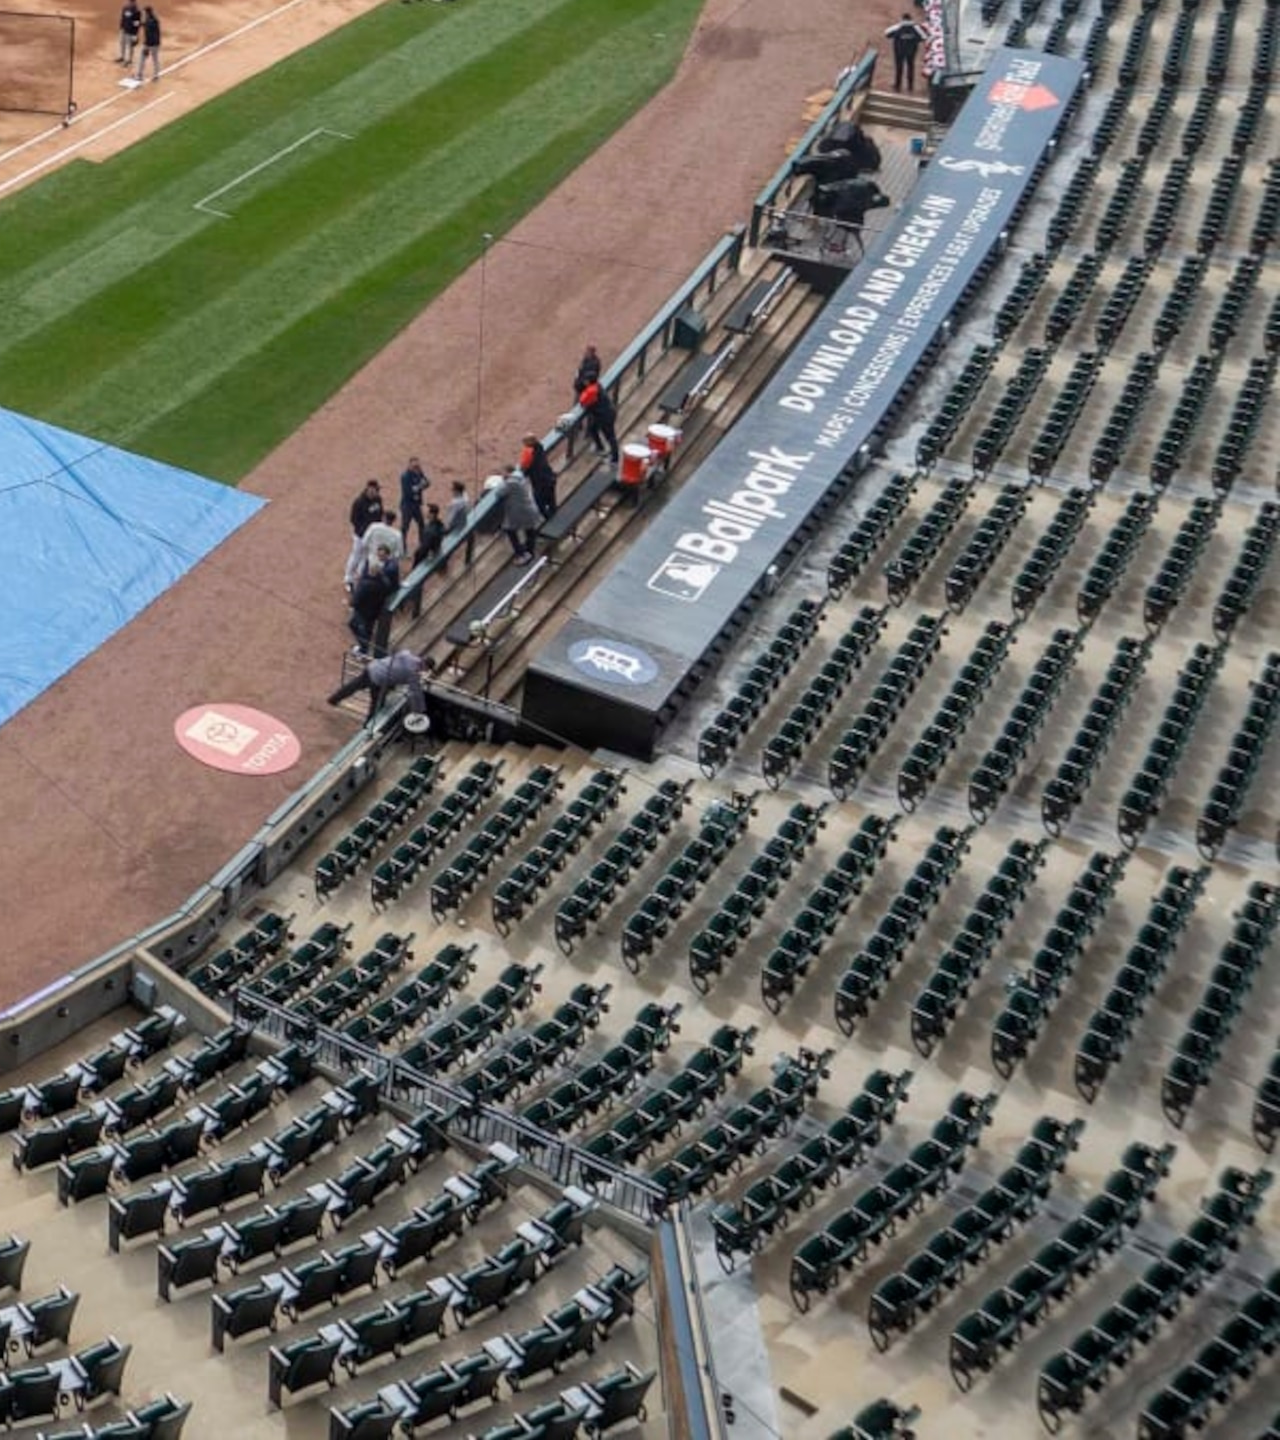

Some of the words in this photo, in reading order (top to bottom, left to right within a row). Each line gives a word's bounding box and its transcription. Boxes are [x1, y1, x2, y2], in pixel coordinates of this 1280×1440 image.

[779, 305, 880, 414] DOWNLOAD
[858, 254, 905, 308] AND
[892, 194, 958, 272] CHECK-IN
[815, 415, 854, 449] MAPS
[848, 329, 908, 408] CONCESSIONS
[897, 259, 954, 331] EXPERIENCES
[674, 445, 812, 564] Ballpark
